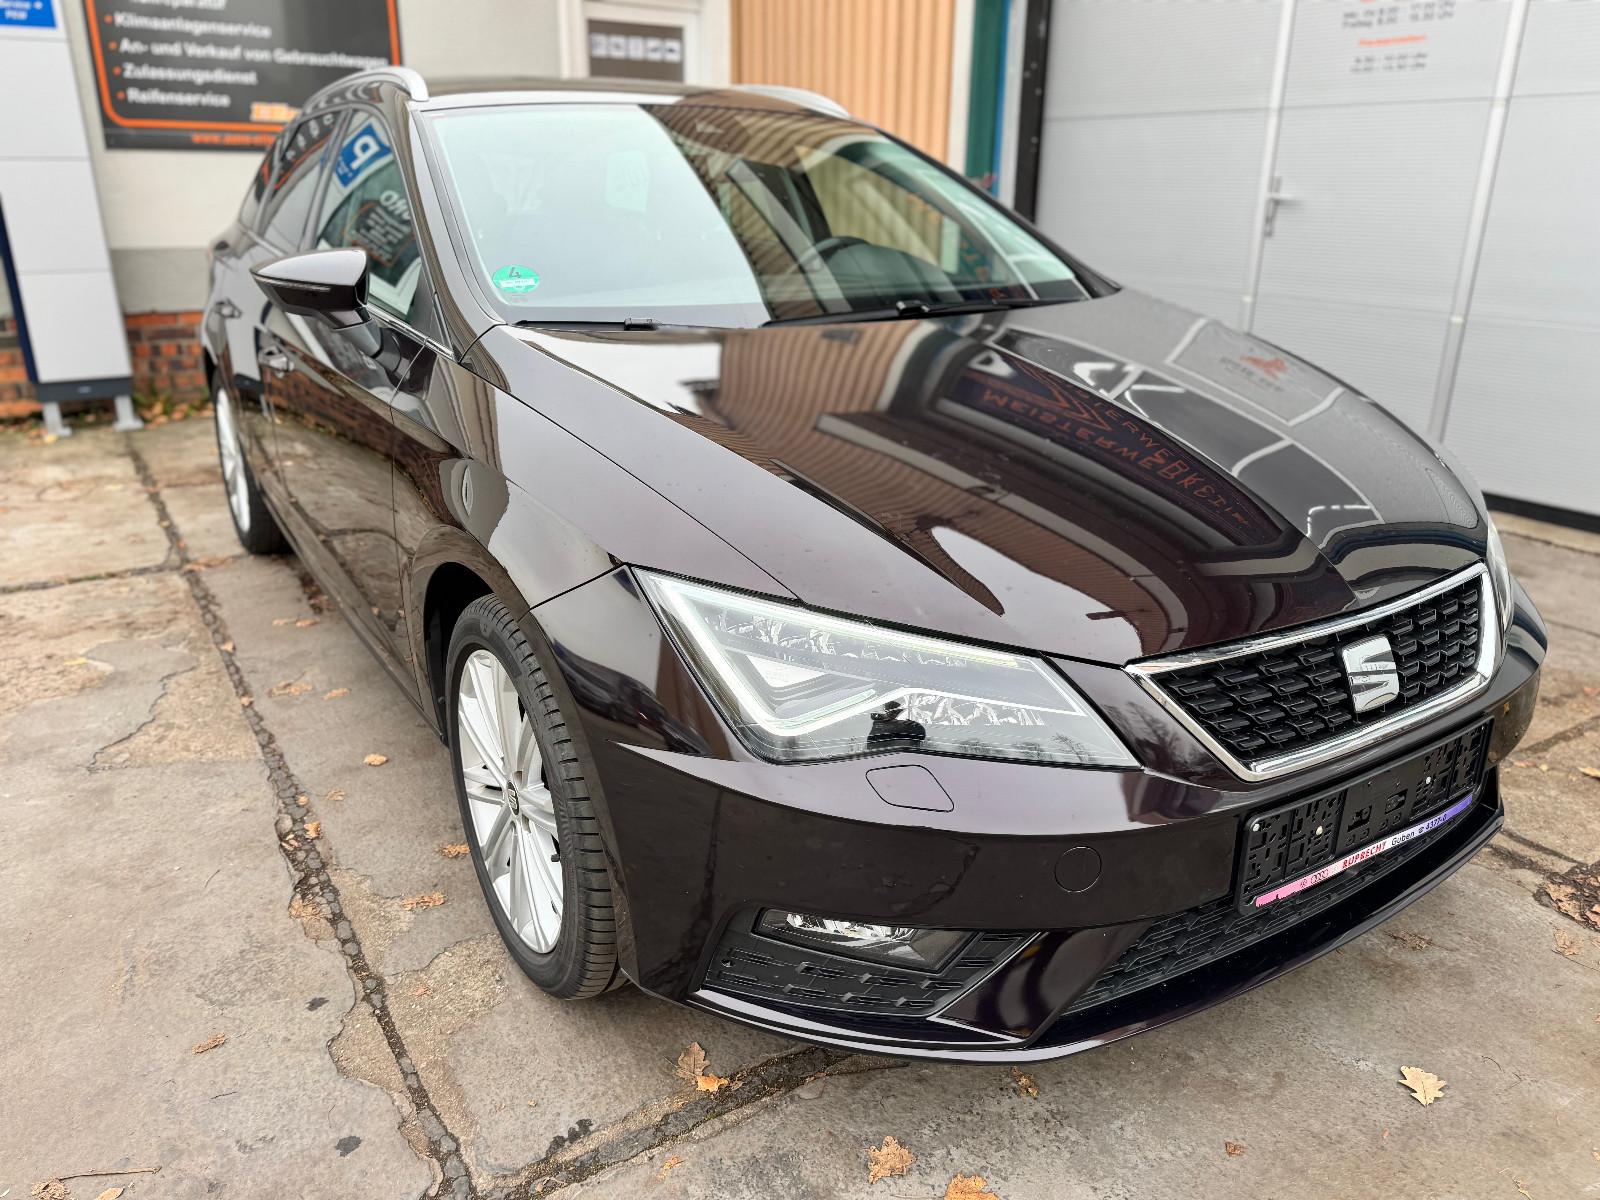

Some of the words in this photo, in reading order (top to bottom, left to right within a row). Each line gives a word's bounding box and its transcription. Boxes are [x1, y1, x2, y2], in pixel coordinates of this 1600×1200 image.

[113, 11, 272, 38] Klimaanlagenservice
[119, 37, 149, 55] An-
[150, 40, 183, 57] und
[184, 41, 243, 61] Verkauf
[243, 48, 272, 63] von
[122, 62, 257, 86] Zulassungsdienst
[126, 87, 231, 108] Reifenservice
[1342, 841, 1387, 869] RUPRECHT
[1391, 831, 1416, 846] Guben
